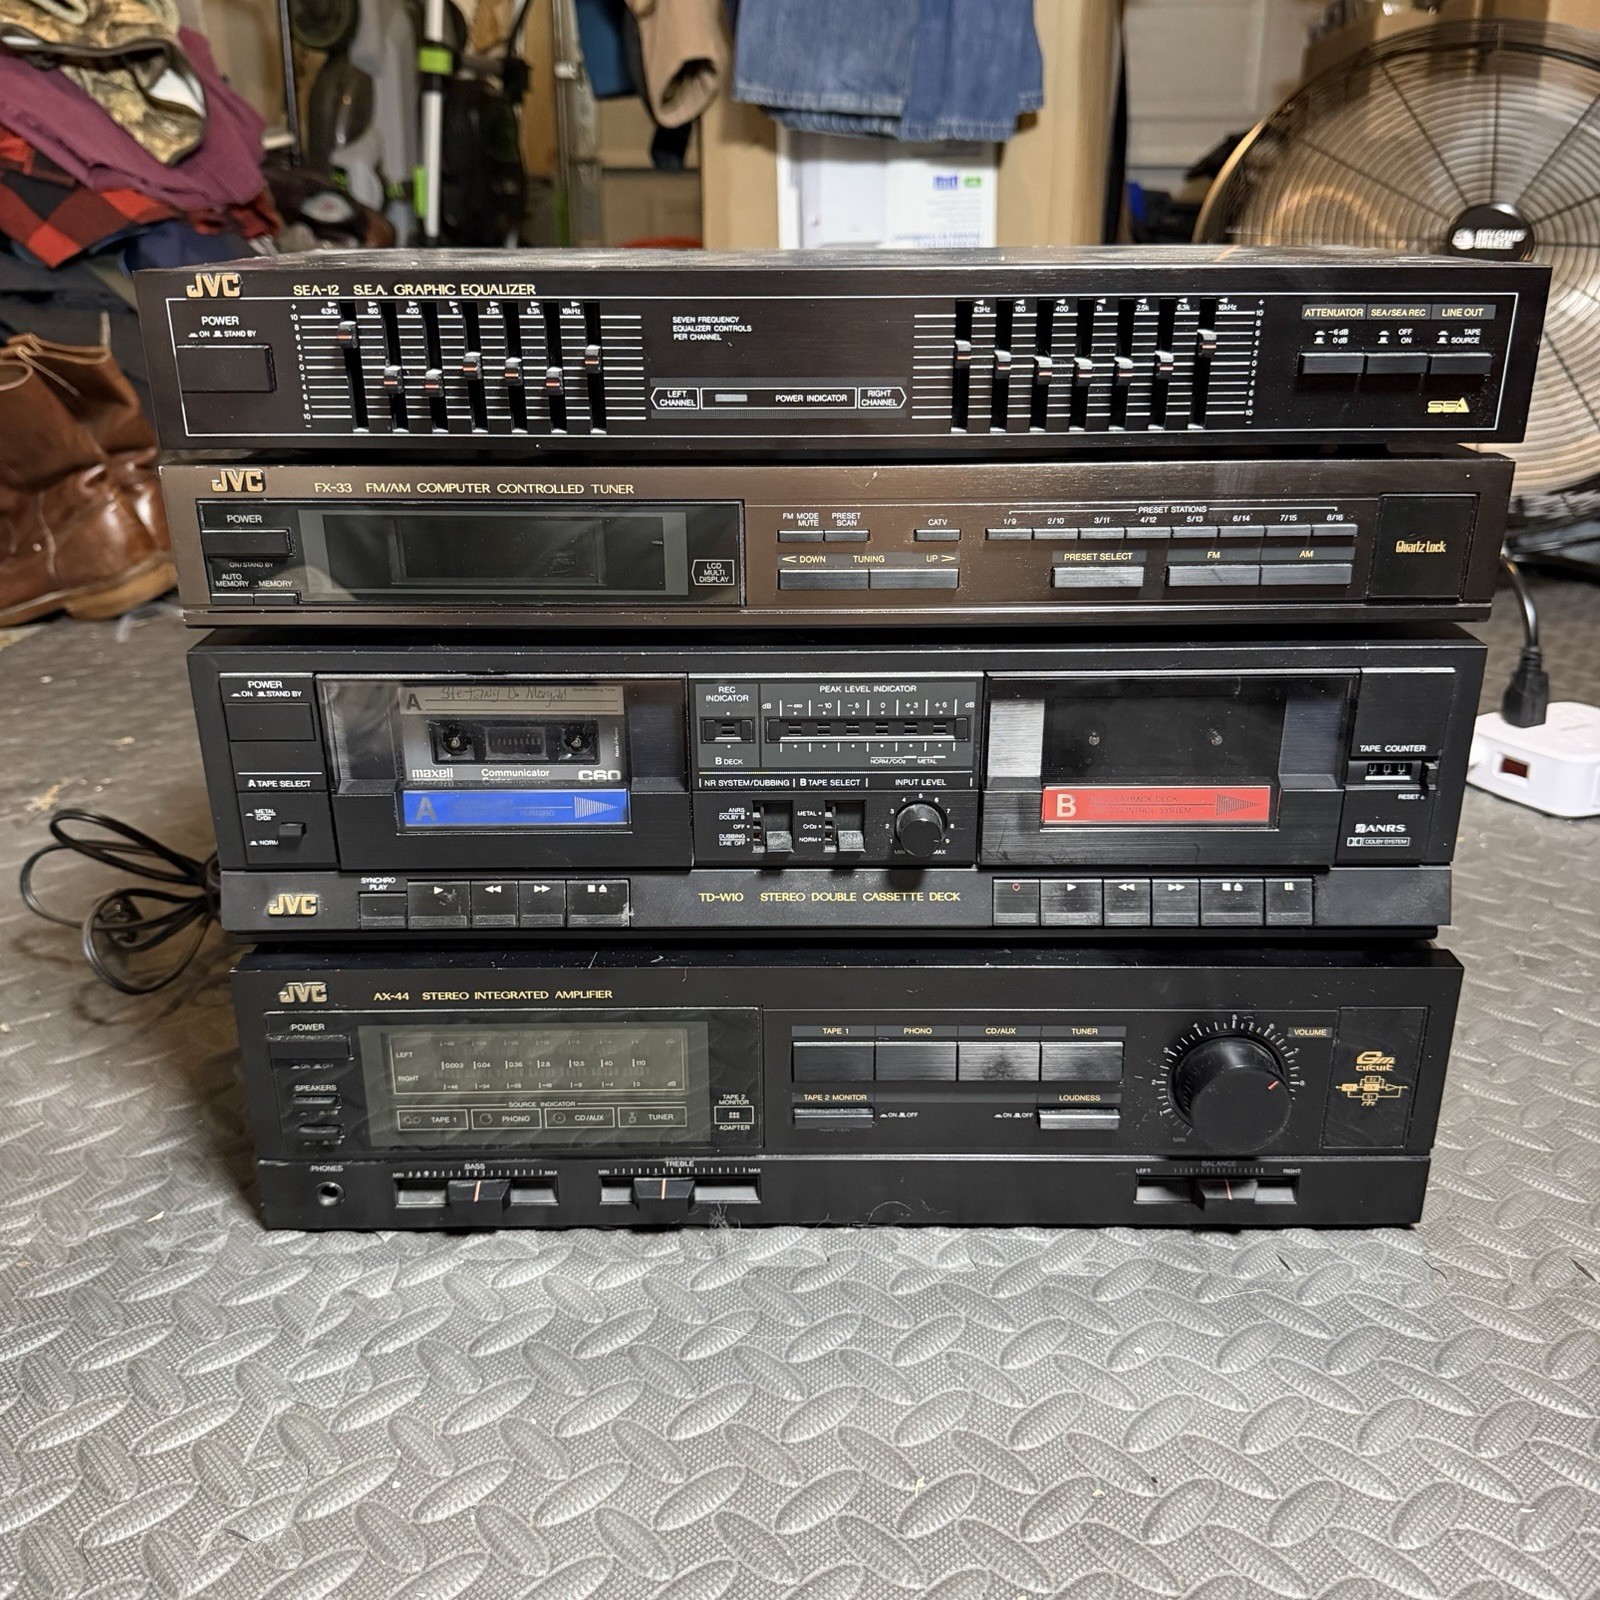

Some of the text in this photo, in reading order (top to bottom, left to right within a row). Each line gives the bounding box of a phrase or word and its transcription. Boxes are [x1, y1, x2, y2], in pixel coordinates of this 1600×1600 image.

[186, 273, 242, 298] JVC
[293, 283, 536, 297] SEA-12 S.E.A. GRAPHIC EQUALIZER
[1304, 308, 1364, 318] ATTENUATOR
[1370, 308, 1426, 317] SEA/SEA REC
[1441, 308, 1484, 317] LINE OUT
[201, 316, 240, 326] POWER
[672, 316, 740, 324] SEVEN FREQUENCY
[672, 324, 752, 333] EQUALIZER CONTROLS
[1398, 328, 1413, 336] OFF
[1463, 328, 1482, 336] TAPE
[199, 330, 257, 338] ON STAND BY
[673, 333, 722, 341] PER CHANNEL
[667, 390, 688, 399] LEFT
[775, 394, 848, 402] POWER INDICATOR
[867, 389, 892, 398] RIGHT
[659, 399, 696, 407] CHANNEL
[861, 398, 898, 407] CHANNEL
[1427, 397, 1470, 413] SEA
[211, 468, 266, 493] JVC
[314, 482, 635, 495] FX-33 FM/AM COMPUTER CONTROLLED TUNER
[1138, 505, 1208, 514] PRESET STATIONS
[226, 514, 263, 524] POWER
[782, 512, 820, 520] FM MODE
[831, 512, 862, 520] PRESET
[1093, 516, 1111, 525] 3/11
[1139, 516, 1157, 524] 4/12
[1186, 515, 1204, 523] 5/13
[1232, 514, 1251, 522] 6/14
[1279, 514, 1298, 522] 7/15
[1326, 513, 1344, 522] 8/16
[797, 519, 820, 527] MUTE
[836, 519, 858, 527] SCAN
[927, 518, 948, 526] CATV
[1003, 517, 1017, 525] 1/9
[1047, 517, 1065, 525] 2/10
[1395, 540, 1426, 554] Quartz
[799, 554, 939, 564] DOWN TUNING UP
[1064, 552, 1133, 562] PRESET SELECT
[1206, 551, 1221, 560] FM
[1299, 550, 1314, 559] AM
[706, 562, 722, 570] LCD
[221, 573, 243, 581] AUTO
[703, 569, 726, 577] MULTI
[247, 680, 283, 689] POWER
[241, 690, 302, 698] ON STAND BY
[718, 686, 736, 694] REC
[819, 685, 918, 694] PEAK LEVEL INDICATOR
[406, 693, 422, 711] A
[705, 694, 750, 702] INDICATOR
[1359, 744, 1427, 753] TAPE COUNTER
[715, 756, 744, 765] B DECK
[412, 767, 454, 779] maxell
[481, 768, 550, 778] Communicator
[578, 769, 622, 781] C60
[247, 779, 312, 788] A TAPE SELECT
[704, 778, 790, 788] NR SYSTEM/DUBBING
[799, 778, 861, 787] B TAPE SELECT
[895, 778, 947, 787] INPUT LEVEL
[416, 796, 438, 821] A
[1056, 793, 1077, 818] B
[1365, 823, 1407, 833] ANRS
[360, 876, 396, 885] SYNCHRO
[698, 892, 961, 902] TD-W10 STEREO DOUBLE CASSETTE DECK
[268, 893, 317, 917] JVC
[278, 981, 328, 1003] JVC
[373, 989, 613, 1001] AX-44 STEREO INTEGRATED AMPLIFIER
[290, 1023, 325, 1031] POWER
[903, 1027, 933, 1035] PHONO
[985, 1027, 1017, 1035] CD/AUX
[1071, 1027, 1099, 1035] TUNER
[1293, 1028, 1328, 1036] VOLUME
[1355, 1064, 1394, 1072] circuit
[294, 1084, 338, 1092] SPEAKERS
[508, 1100, 576, 1108] SOURCE INDICATOR
[501, 1115, 531, 1123] PHONO
[574, 1114, 605, 1122] CD/AUX
[648, 1113, 674, 1121] TUNER
[665, 1160, 695, 1168] TREBLE
[310, 1165, 344, 1173] PHONES
